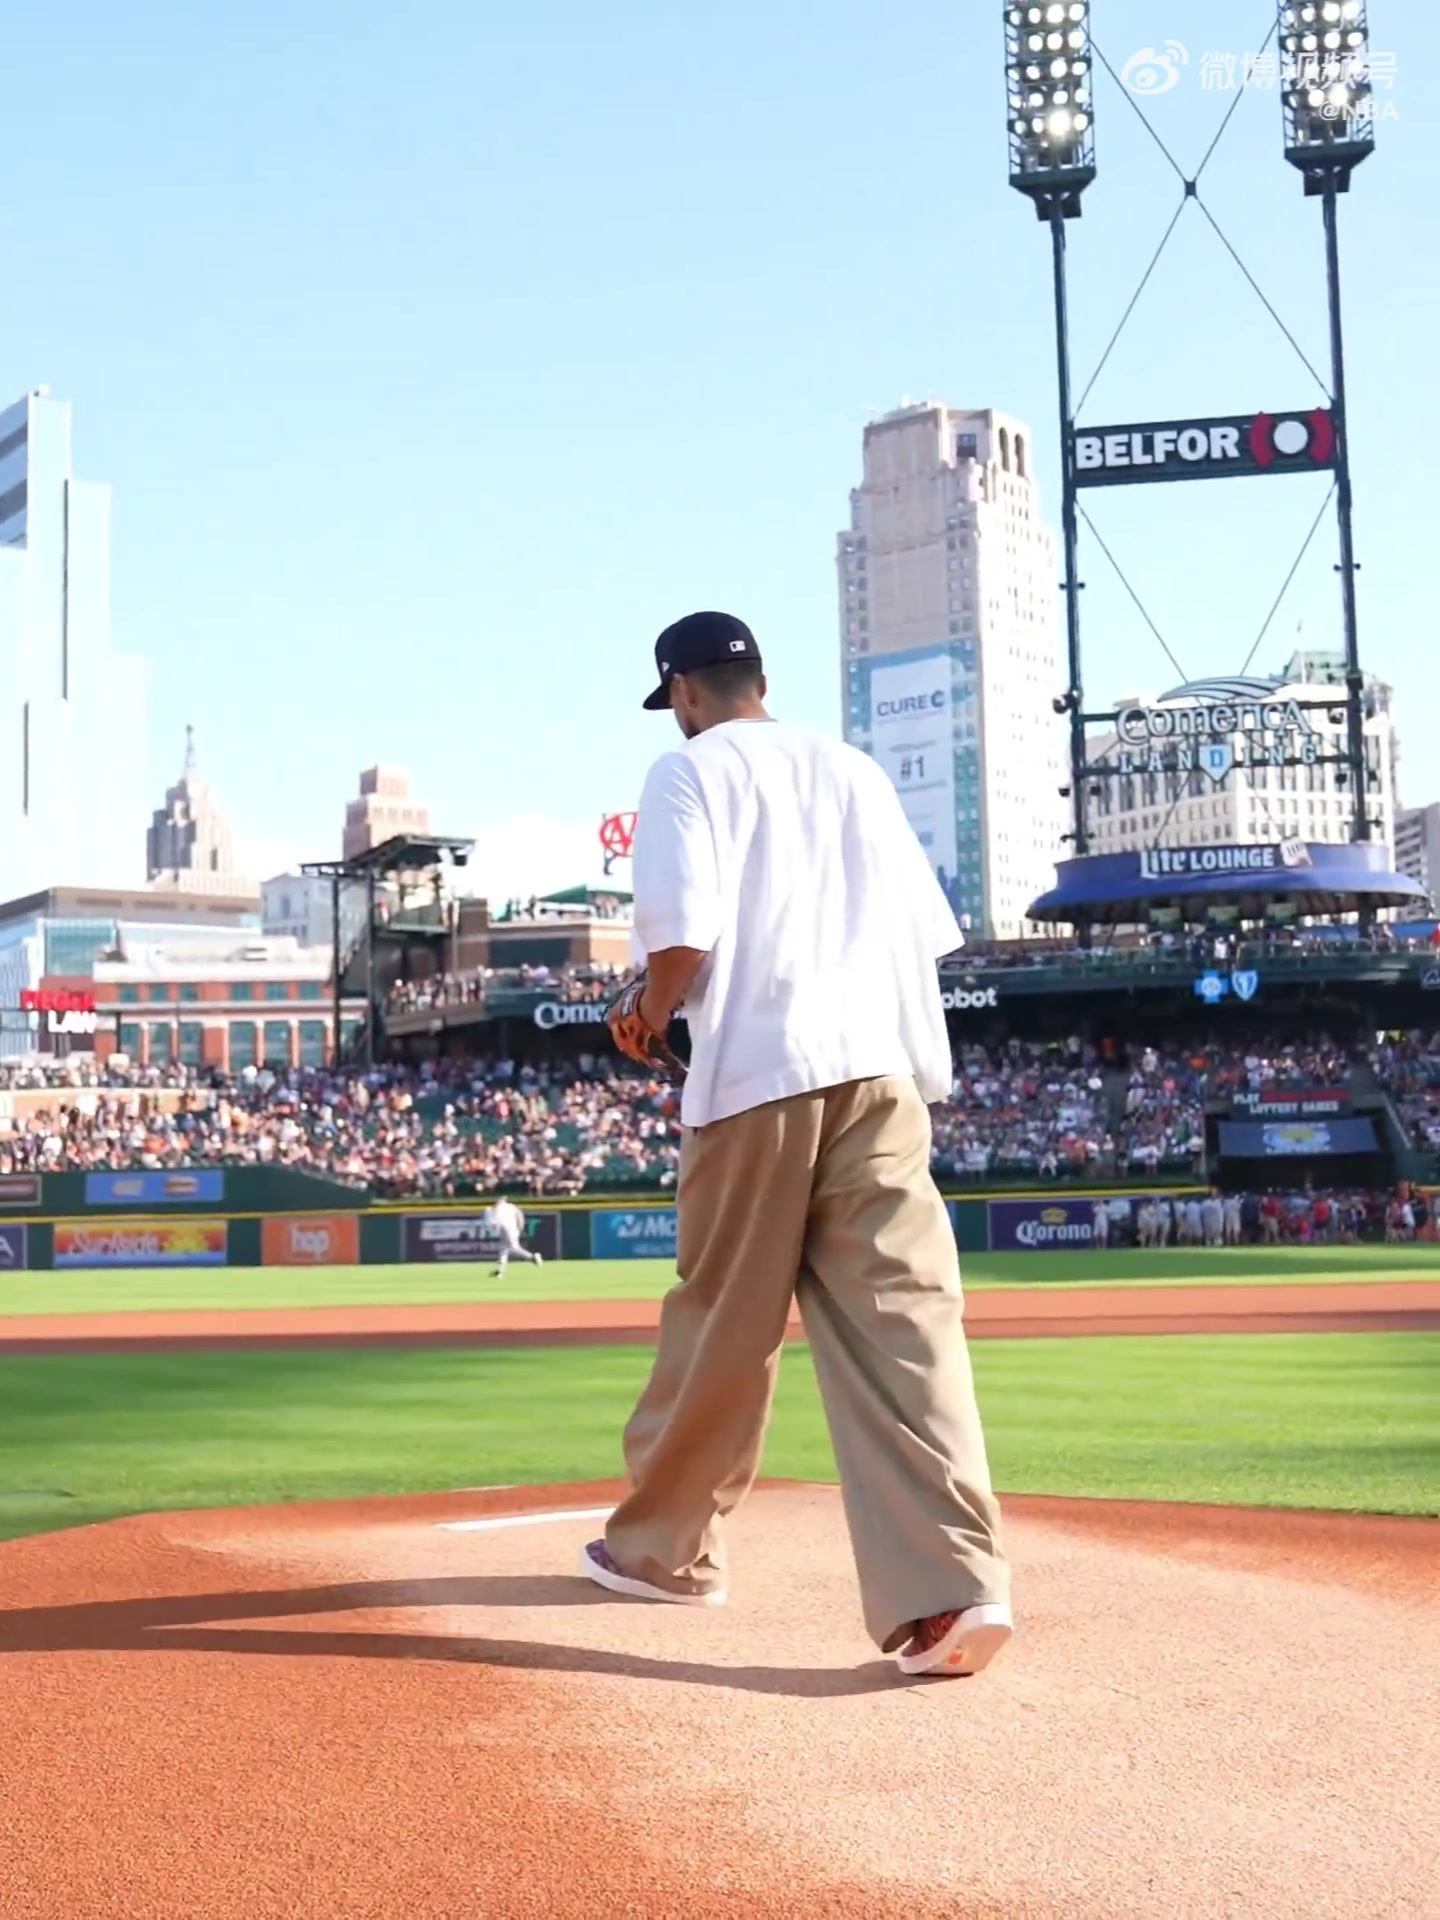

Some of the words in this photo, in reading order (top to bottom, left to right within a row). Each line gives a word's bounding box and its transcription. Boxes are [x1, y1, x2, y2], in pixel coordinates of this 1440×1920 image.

[1075, 426, 1241, 469] BELFOR
[900, 755, 925, 780] #1
[1189, 846, 1275, 871] LOUNGE
[290, 1224, 330, 1260] hop
[1016, 1221, 1092, 1246] Corona
